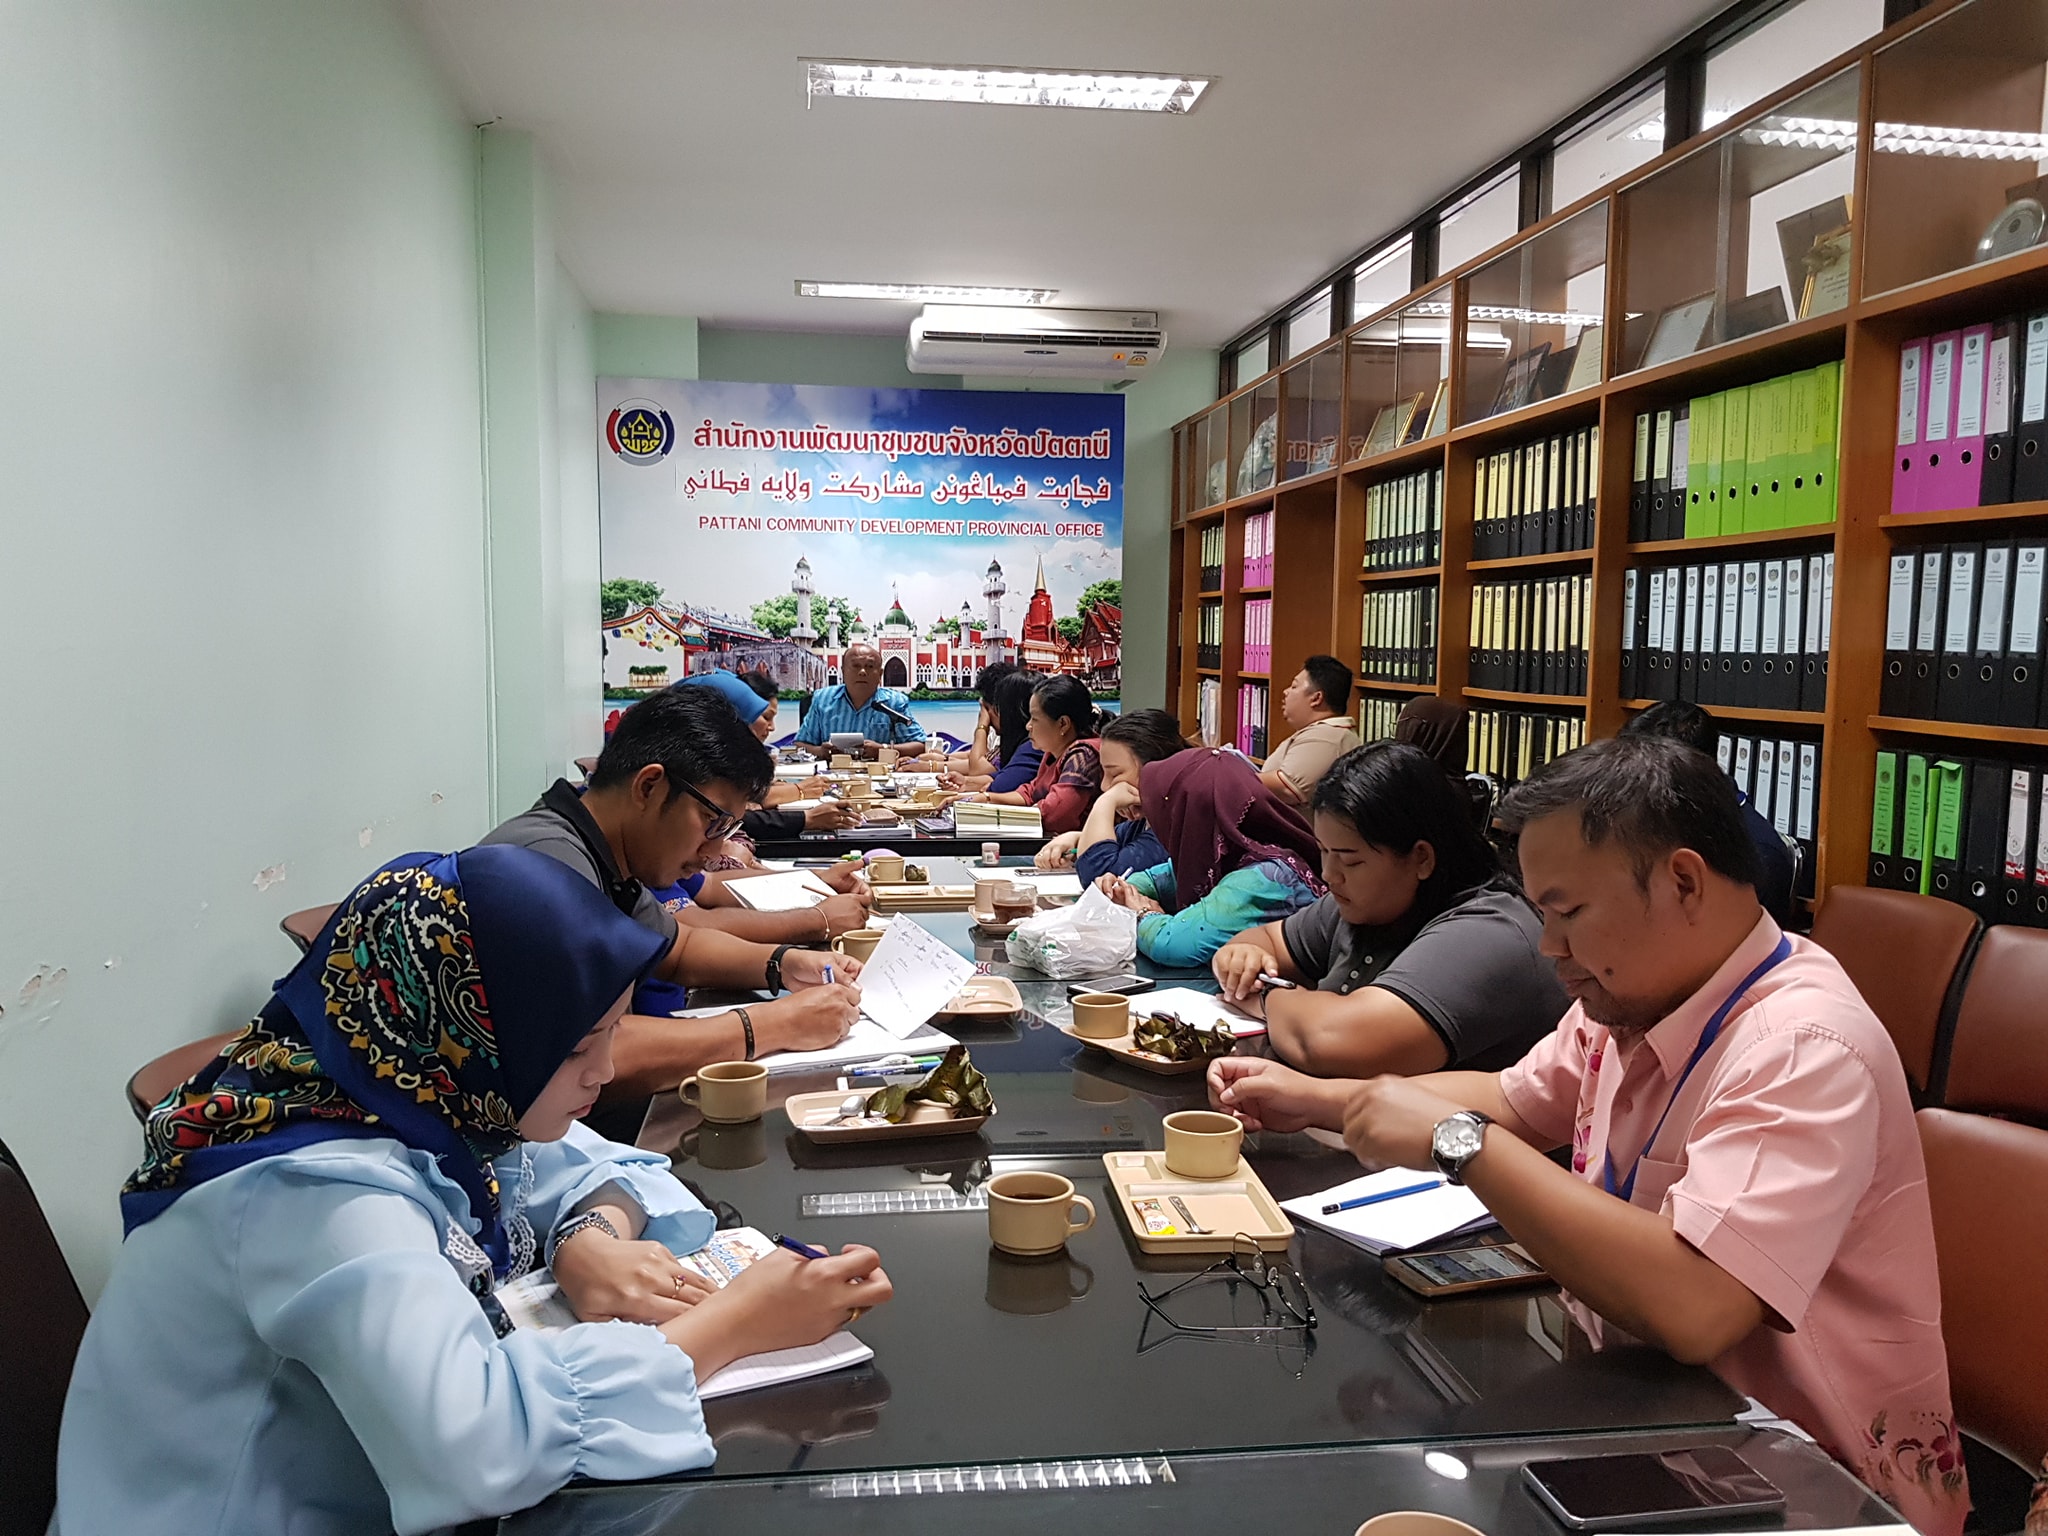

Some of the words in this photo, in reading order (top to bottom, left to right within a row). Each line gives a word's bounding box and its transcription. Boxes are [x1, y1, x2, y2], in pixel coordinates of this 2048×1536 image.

[693, 418, 1110, 460] สำนักงานพัฒนาชุมชนจังหวัดปัตตานี
[699, 516, 761, 530] PATTANI
[766, 518, 856, 532] COMMUNITY
[861, 520, 963, 535] DEVELOPMENT
[968, 521, 1050, 536] PROVINCIAL
[1055, 523, 1103, 537] OFFICE
